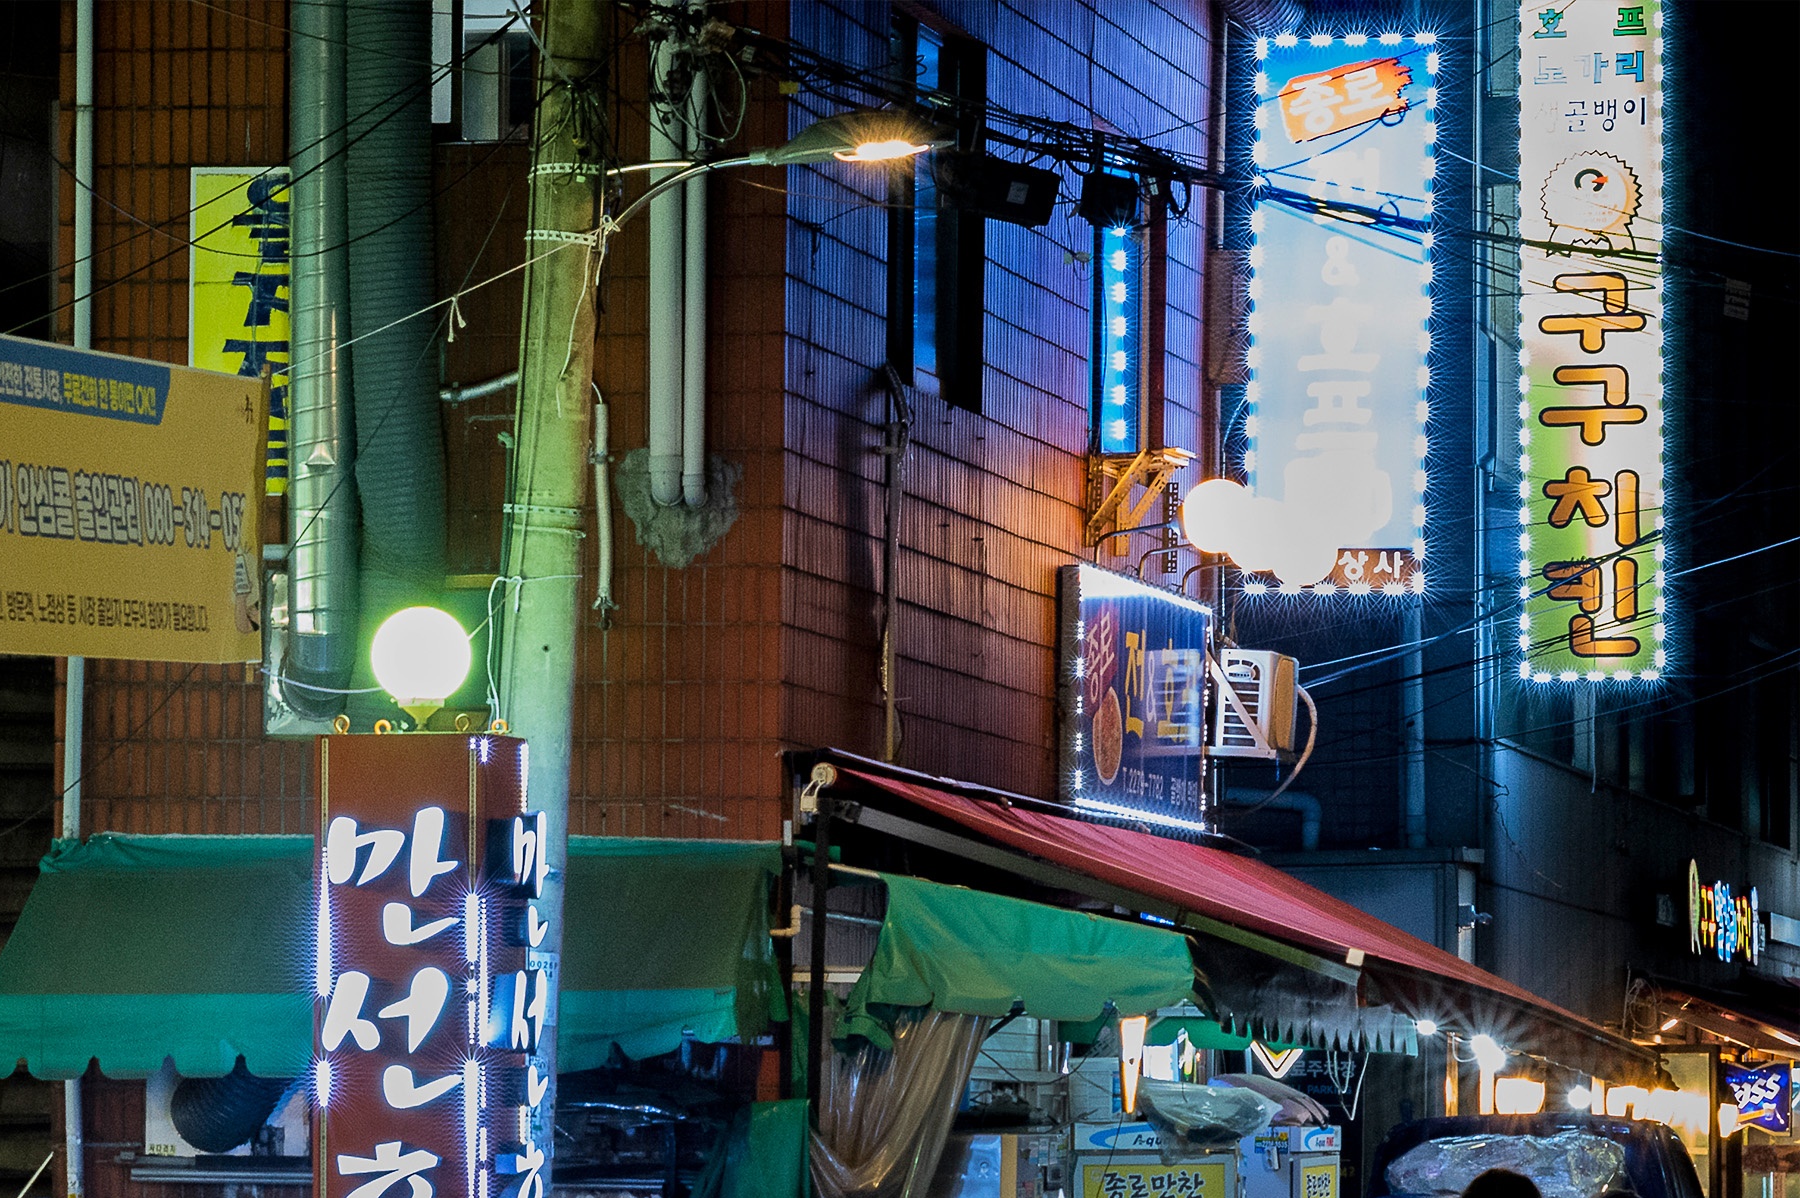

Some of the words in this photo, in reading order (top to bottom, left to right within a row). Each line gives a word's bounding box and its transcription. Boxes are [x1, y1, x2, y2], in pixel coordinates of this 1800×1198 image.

[1533, 6, 1647, 39] 호프
[1289, 67, 1394, 133] 종로
[1534, 50, 1644, 84] 노가리
[1538, 271, 1648, 657] 구구치킨
[17, 463, 76, 540] 안심콜
[75, 468, 143, 546] 출입관리
